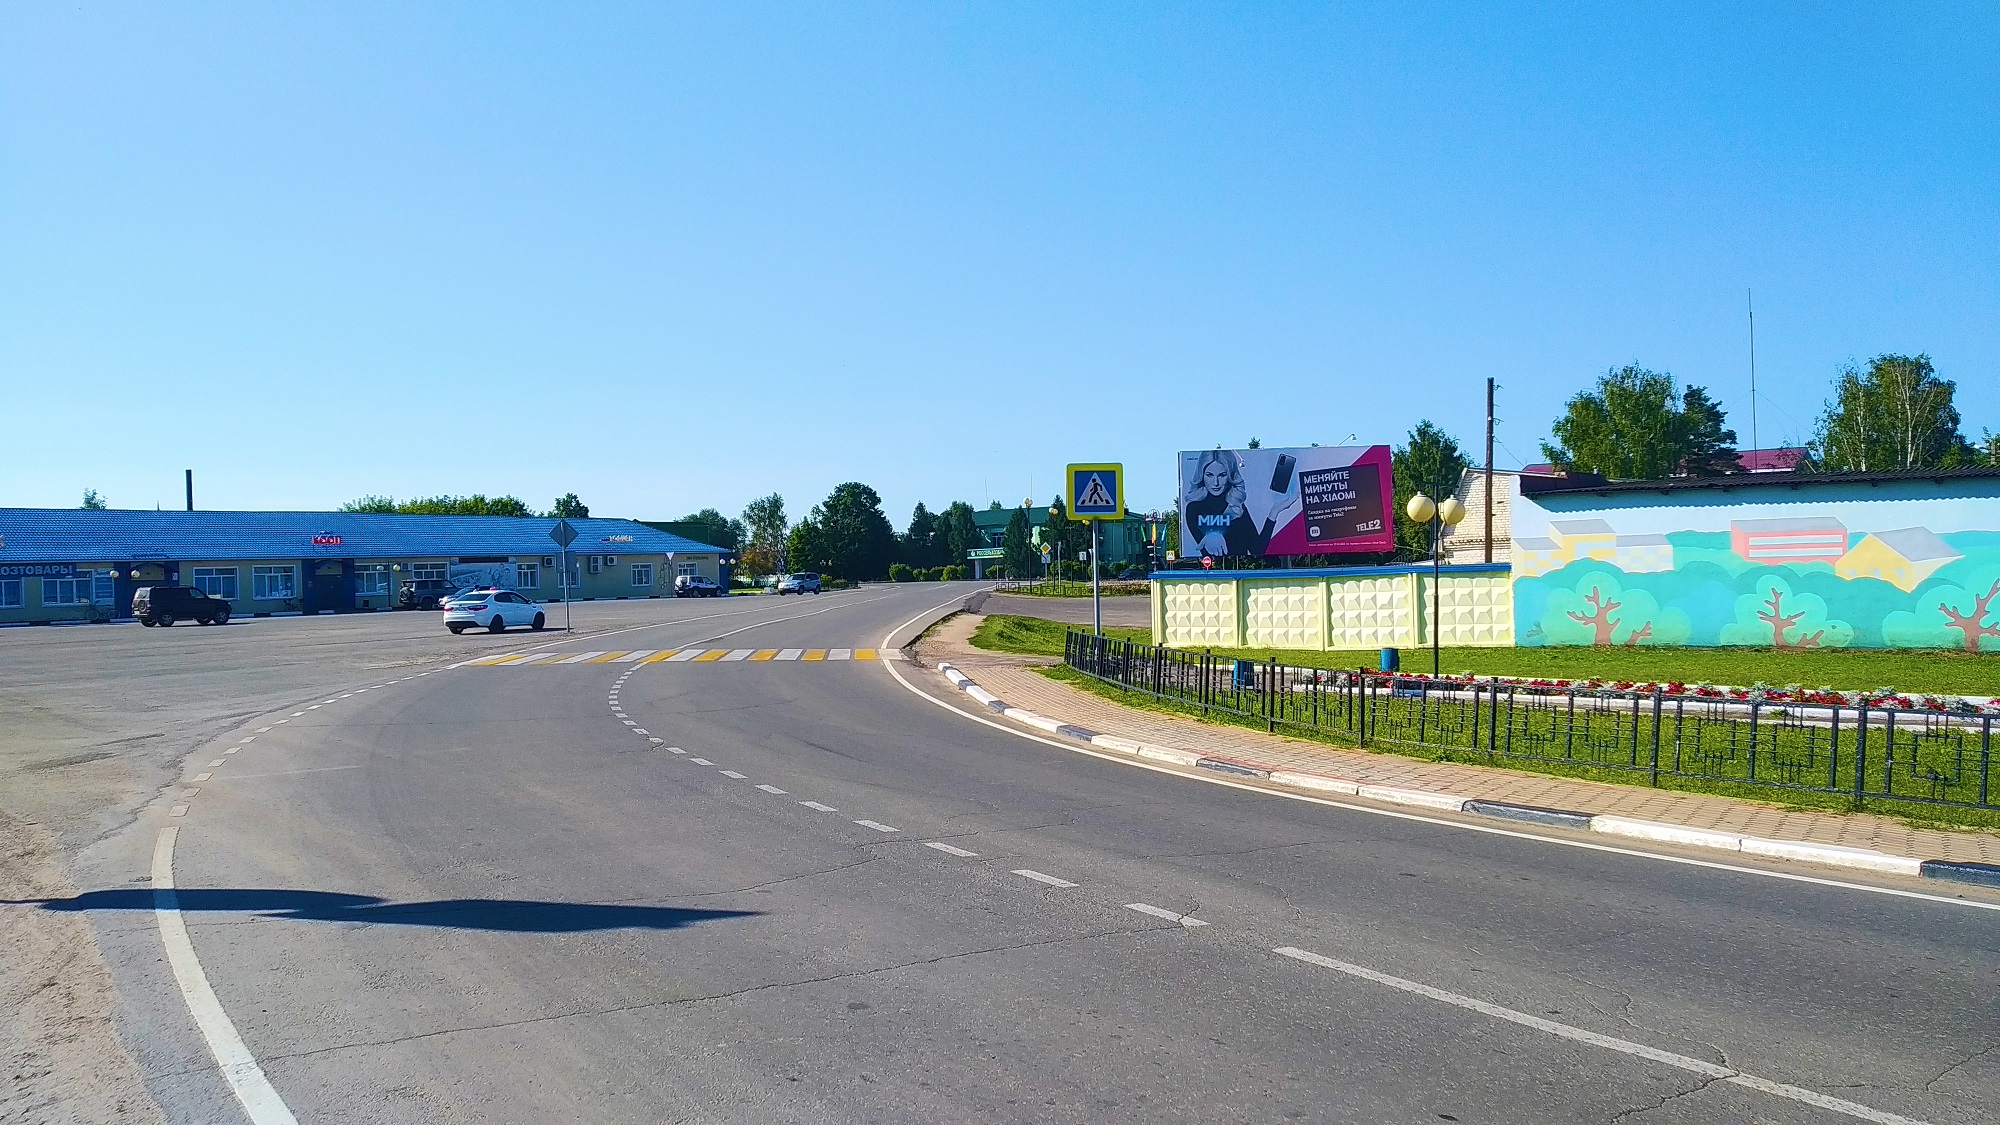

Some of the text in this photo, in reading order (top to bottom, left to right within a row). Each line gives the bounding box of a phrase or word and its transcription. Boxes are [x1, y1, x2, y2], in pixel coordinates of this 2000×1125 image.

[1304, 471, 1350, 484] МЕНЯЙТЕ
[1305, 482, 1348, 494] МИНУТЫ
[1306, 490, 1357, 505] НА XIAOMI
[1197, 514, 1231, 527] МИН
[1356, 519, 1381, 532] TELE2
[0, 564, 73, 576] ОЗТОВАРЫ
